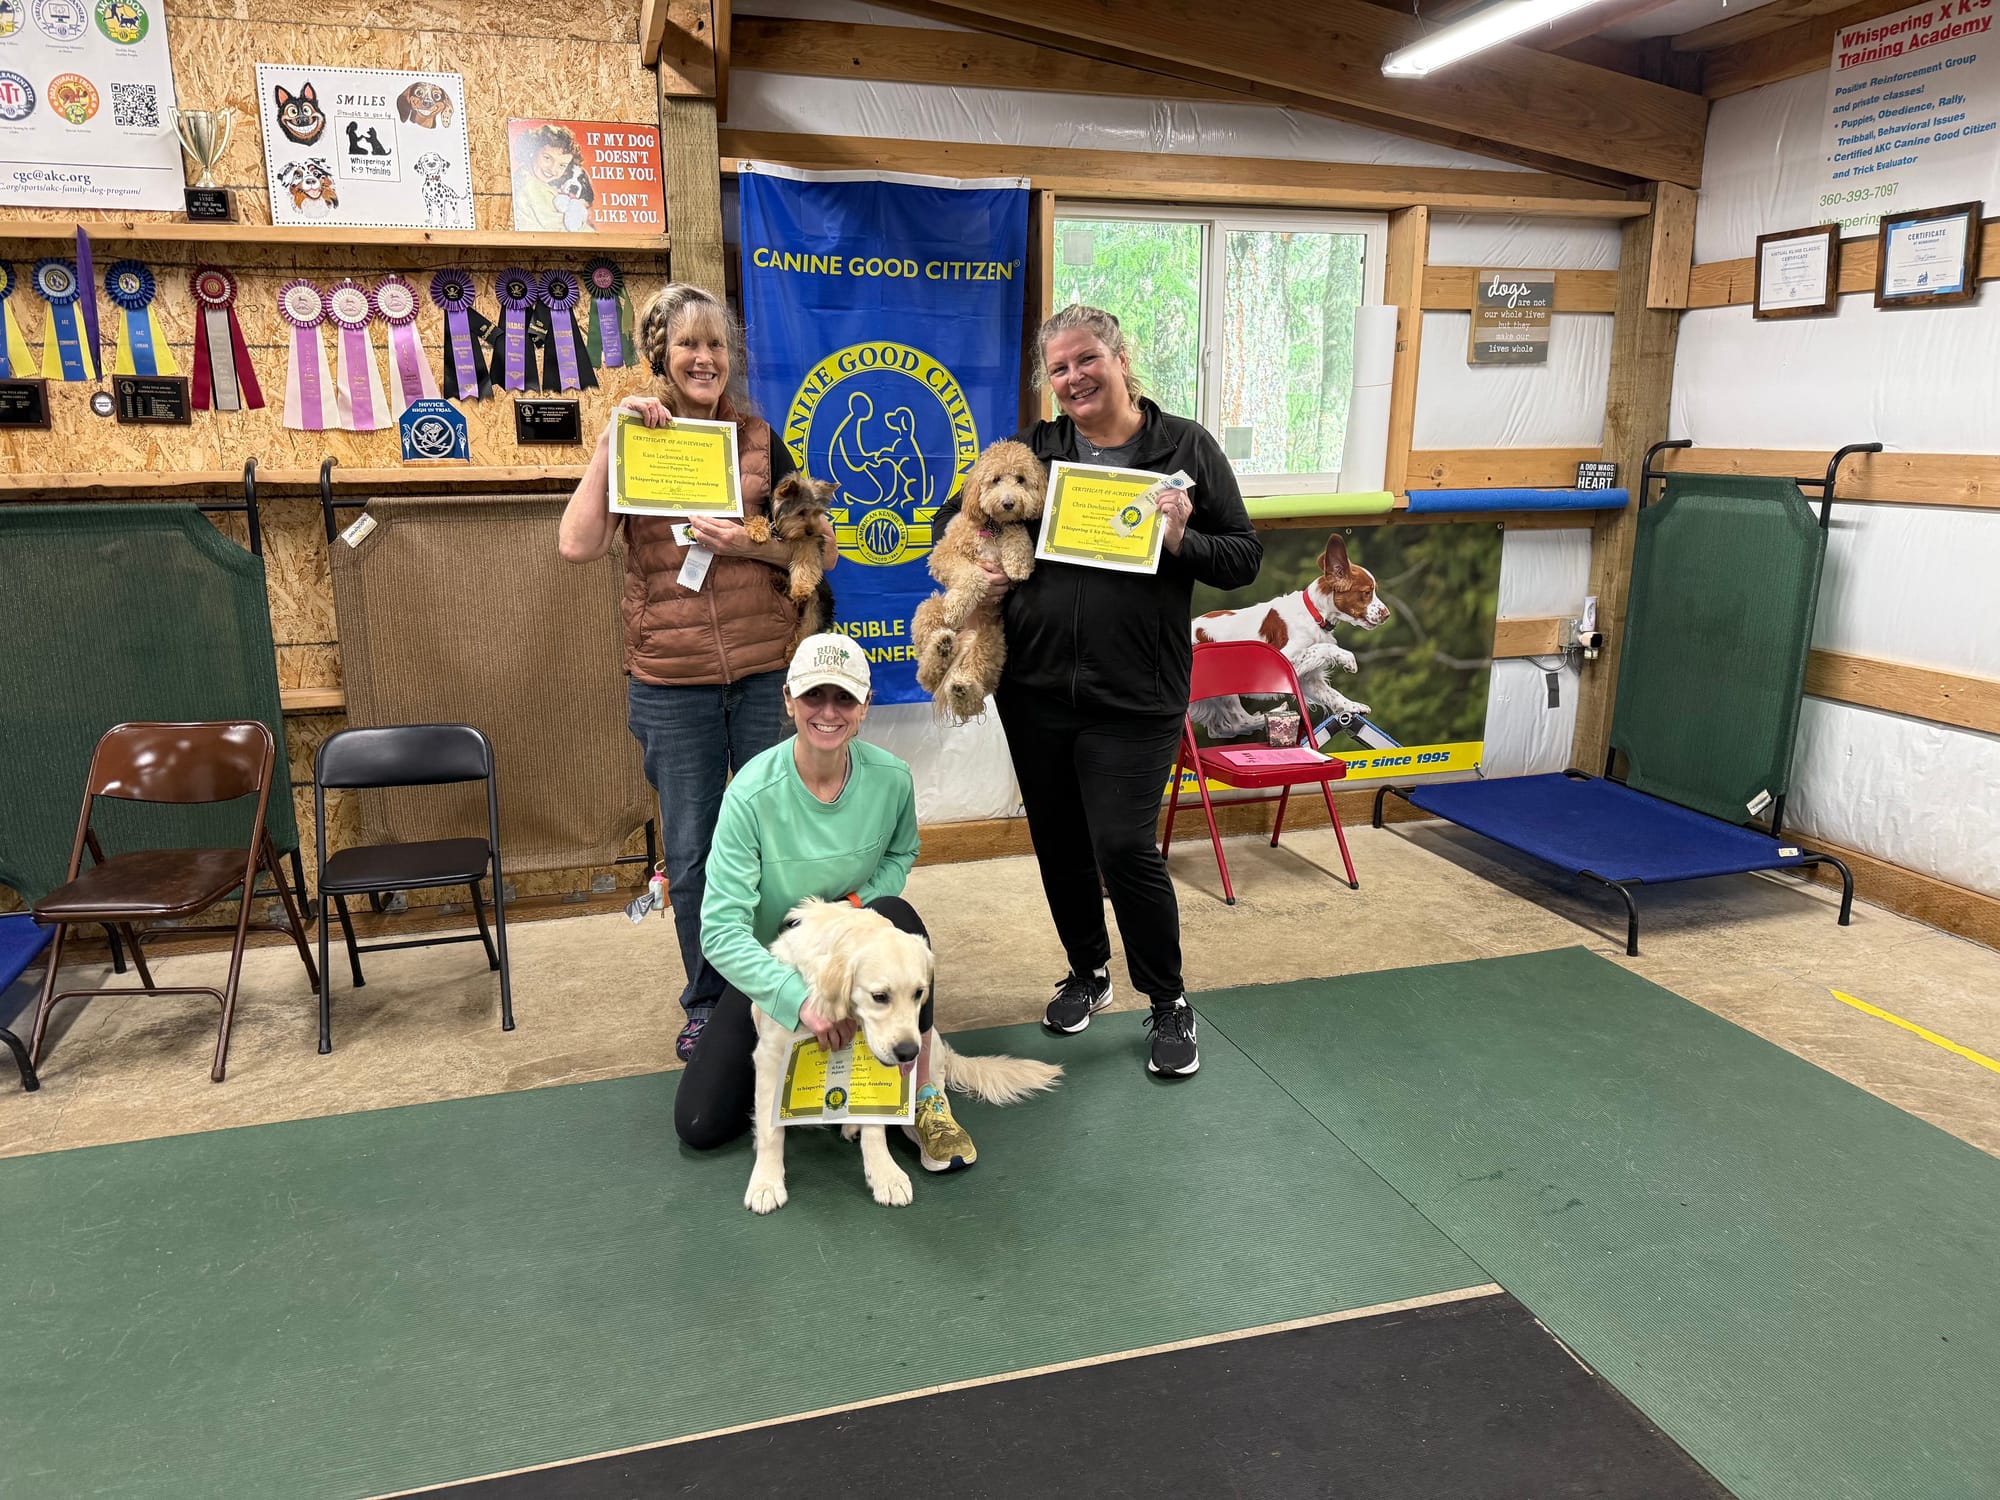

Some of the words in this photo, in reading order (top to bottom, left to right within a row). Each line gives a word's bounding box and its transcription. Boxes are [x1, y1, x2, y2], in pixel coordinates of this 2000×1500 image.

[1842, 12, 1933, 49] Whispering
[1938, 3, 1953, 21] X
[1838, 41, 1904, 68] Training
[1908, 15, 1993, 50] Academy
[1834, 81, 1867, 97] Positive
[1870, 62, 1942, 87] Reinforcement
[1945, 54, 1977, 69] Group
[336, 94, 386, 107] SMILES
[1832, 102, 1850, 114] and
[1852, 96, 1880, 110] private
[1883, 84, 1925, 101] classes!
[1841, 115, 1875, 129] Puppies,
[1878, 102, 1935, 118] Obedience,
[1938, 93, 1966, 107] Rally,
[1838, 130, 1876, 147] Treibball,
[1877, 119, 1930, 137] Behavioral
[1933, 112, 1966, 123] Issues
[586, 132, 601, 146] IF
[603, 133, 625, 147] MY
[627, 134, 655, 148] DOG
[1833, 147, 1873, 163] Certified
[1874, 142, 1891, 155] AKC
[1894, 136, 1930, 149] Canine
[1933, 128, 1960, 141] Good
[1963, 121, 1997, 136] Citizen
[350, 157, 386, 167] Whispering
[595, 149, 649, 164] DOESN'T
[351, 166, 364, 174] K-9
[365, 166, 392, 176] Training
[591, 166, 625, 180] LIKE
[627, 167, 657, 183] YOU,
[1832, 168, 1850, 179] and
[1853, 162, 1875, 176] Trick
[1876, 155, 1918, 171] Evaluator
[13, 169, 92, 185] cgc@akc.org
[602, 193, 607, 206] I
[610, 193, 649, 207] DON'T
[1819, 182, 1899, 207] 360-393-7097
[594, 209, 628, 223] LIKE
[631, 210, 660, 223] YOU.
[1907, 228, 1946, 241] CERTIFICATE
[753, 247, 842, 276] CANINE
[849, 257, 919, 279] GOOD
[1487, 274, 1531, 309] dogs
[1517, 299, 1531, 307] are
[1524, 310, 1545, 319] lives
[1513, 321, 1531, 331] they
[1488, 344, 1510, 353] lives
[1512, 344, 1533, 353] whole
[838, 346, 920, 373] GOOD
[926, 367, 977, 475] CITIZEN
[633, 435, 667, 444] CERTIFICATE
[677, 440, 713, 448] ACHIEVEMENT
[1585, 463, 1597, 471] DOG
[1071, 486, 1103, 494] CERTIFICATE
[1577, 476, 1613, 489] HEART
[867, 519, 898, 554] AKC
[832, 619, 905, 639] NSIBLE
[817, 645, 840, 656] RUN
[862, 645, 917, 664] NNER
[813, 654, 846, 669] LUCKY
[1346, 759, 1367, 770] ers
[1371, 756, 1412, 768] since
[1417, 752, 1450, 763] 1995
